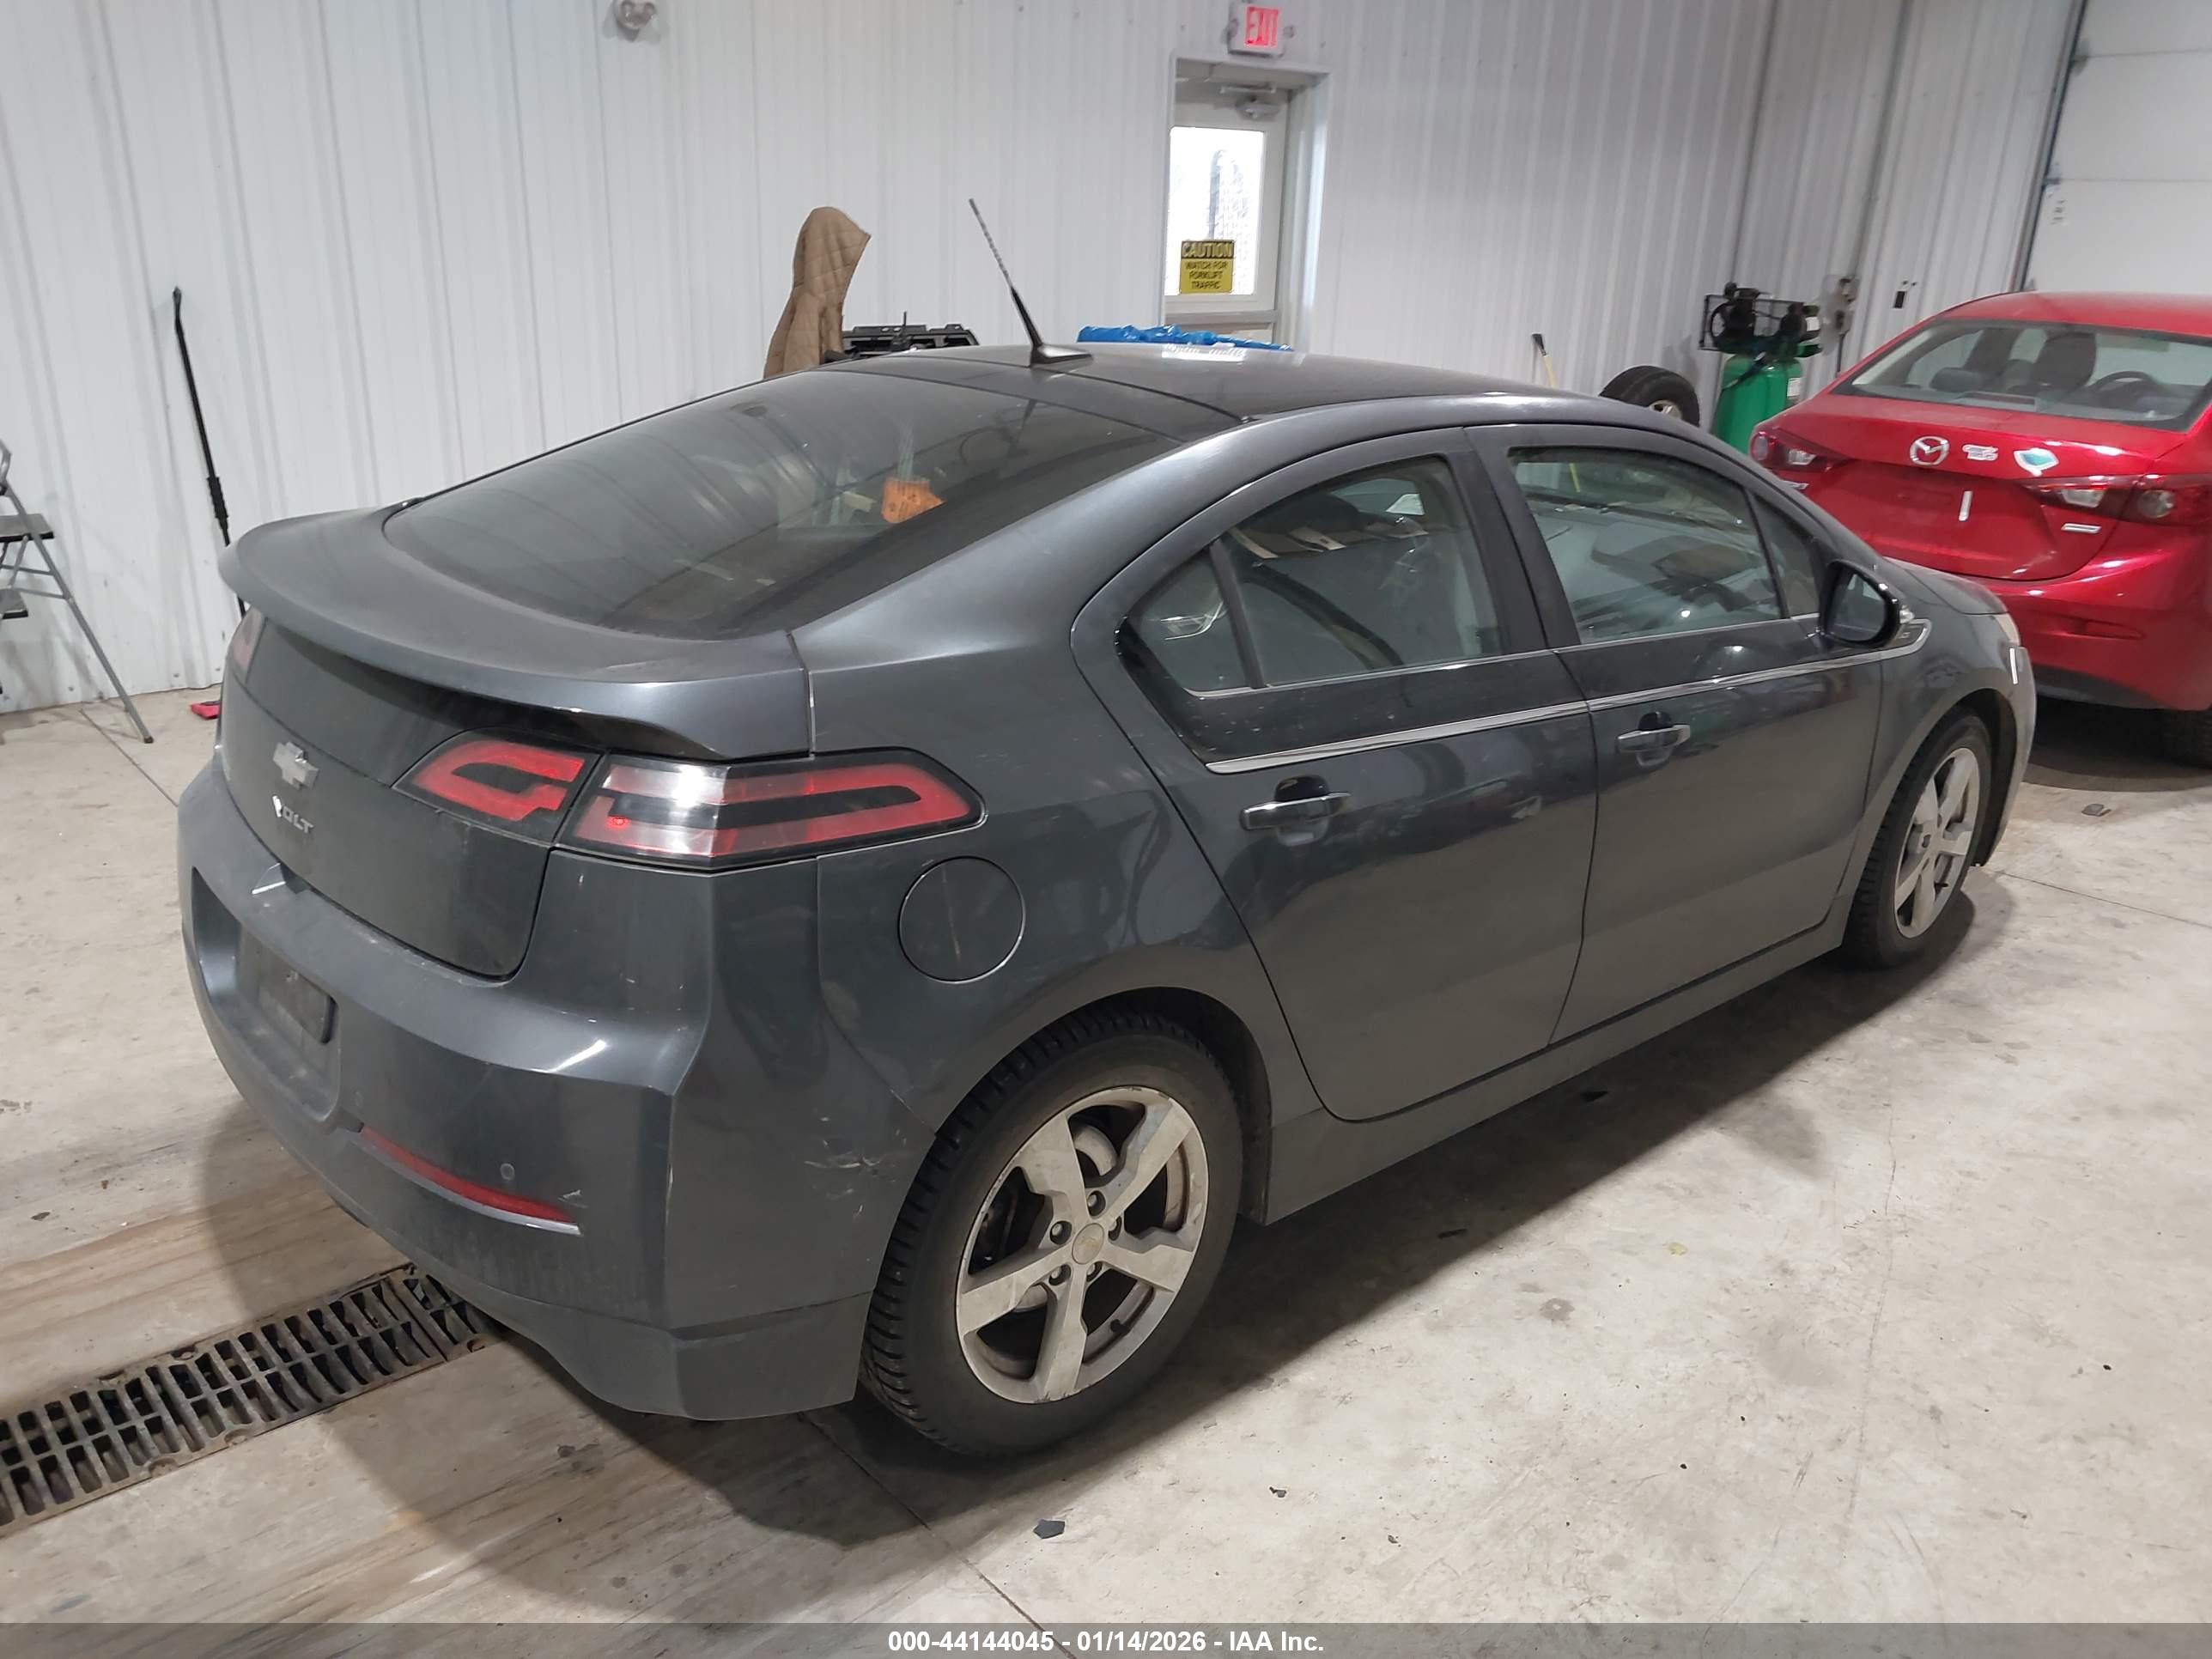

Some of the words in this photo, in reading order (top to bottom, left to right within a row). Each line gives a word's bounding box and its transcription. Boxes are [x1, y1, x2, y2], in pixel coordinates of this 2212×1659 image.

[1246, 7, 1278, 46] EXIT
[1182, 242, 1233, 257] CAUTION
[1188, 270, 1223, 279] FORKLIFT
[1191, 280, 1221, 289] TRAFFIC
[272, 795, 314, 834] VOLT
